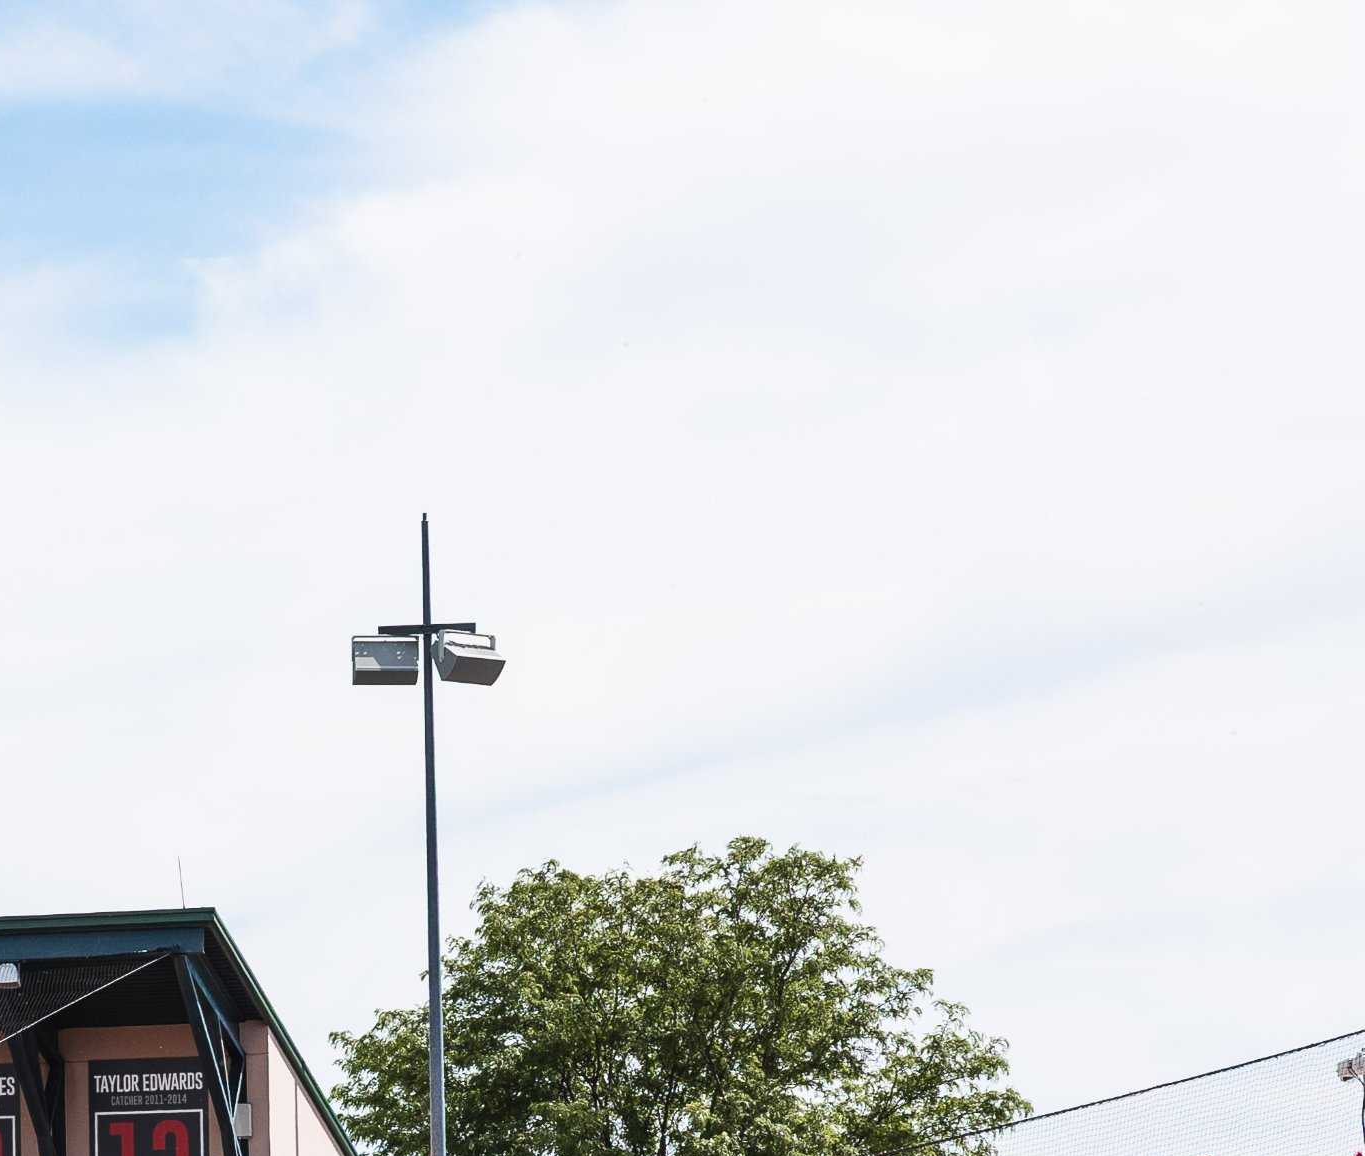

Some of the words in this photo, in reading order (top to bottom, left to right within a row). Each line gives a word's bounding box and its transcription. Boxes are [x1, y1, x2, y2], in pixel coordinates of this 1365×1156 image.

[93, 1073, 140, 1093] TAYLOR
[142, 1071, 204, 1092] EDWARDS
[110, 1095, 143, 1106] CATCHER
[145, 1093, 188, 1105] 2011-2014
